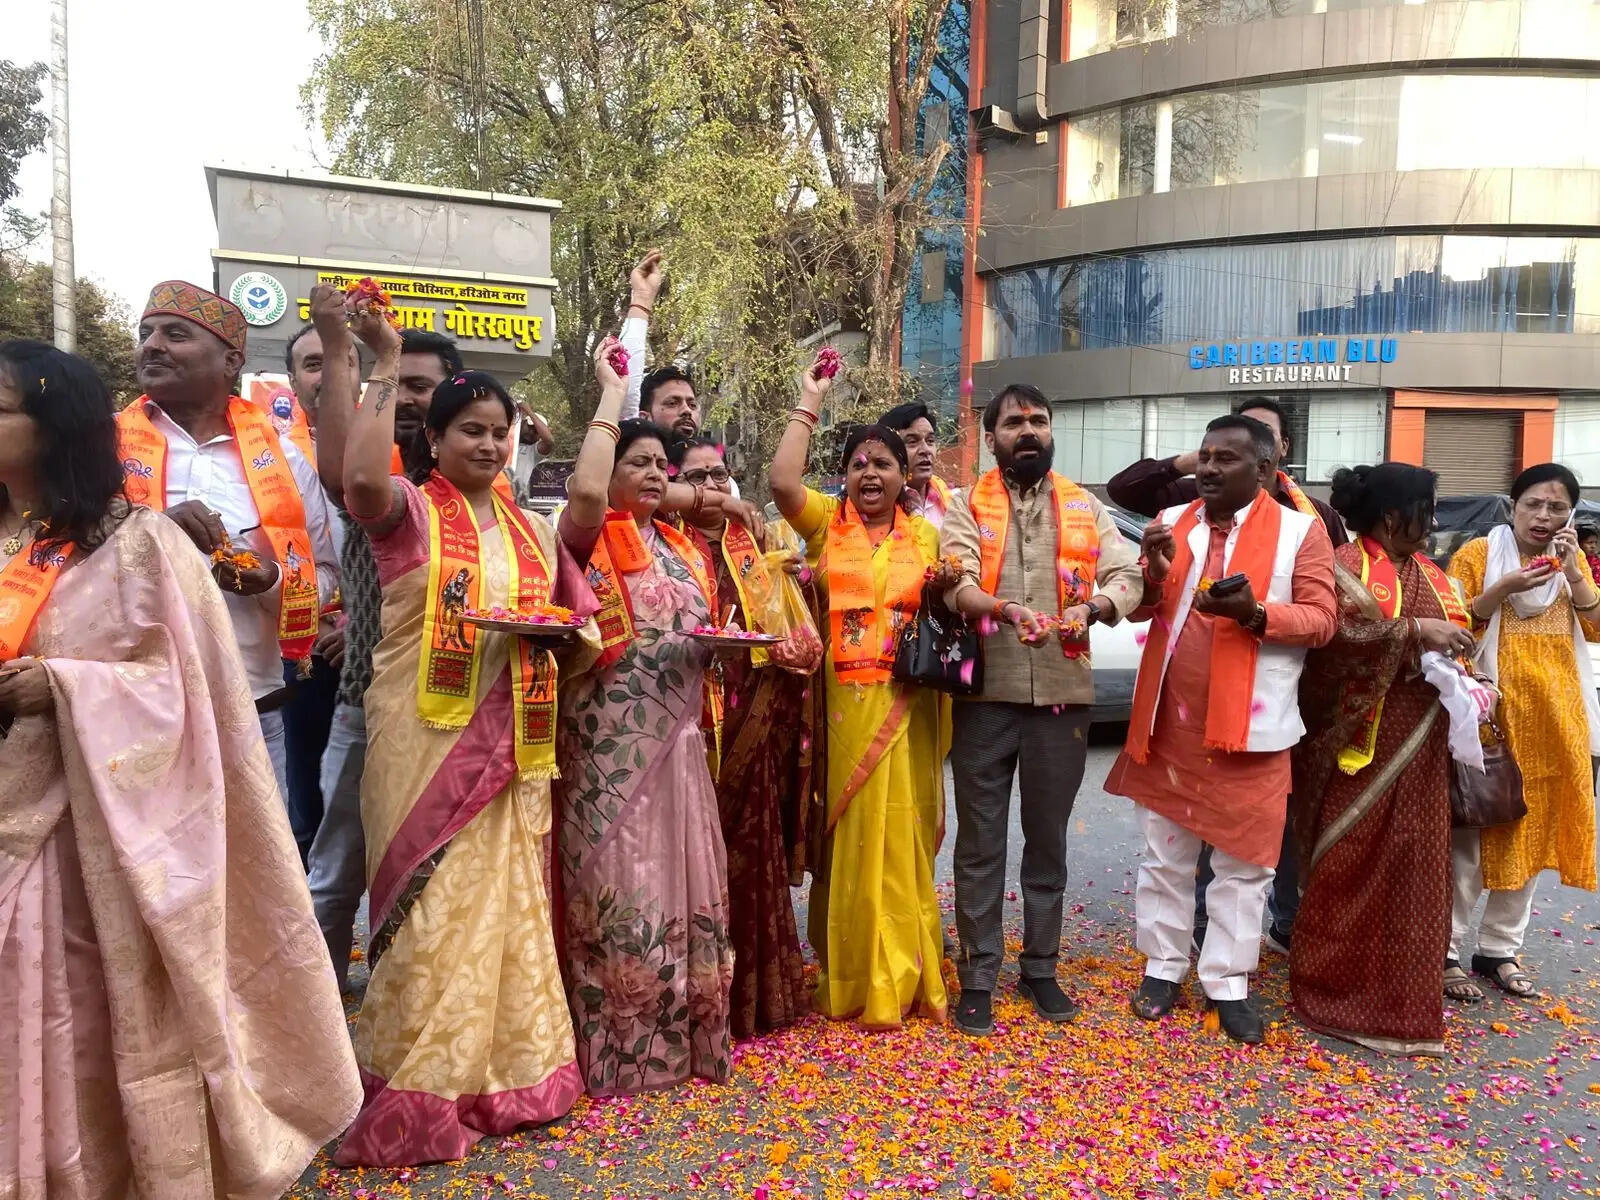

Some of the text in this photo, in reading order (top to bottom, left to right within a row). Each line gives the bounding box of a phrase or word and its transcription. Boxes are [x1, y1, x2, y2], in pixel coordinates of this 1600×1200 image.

[502, 291, 527, 302] नगर
[443, 303, 543, 350] गोरखपुर
[1190, 339, 1397, 369] CARIBBEAN BLU
[1229, 365, 1352, 384] RESTAURANT
